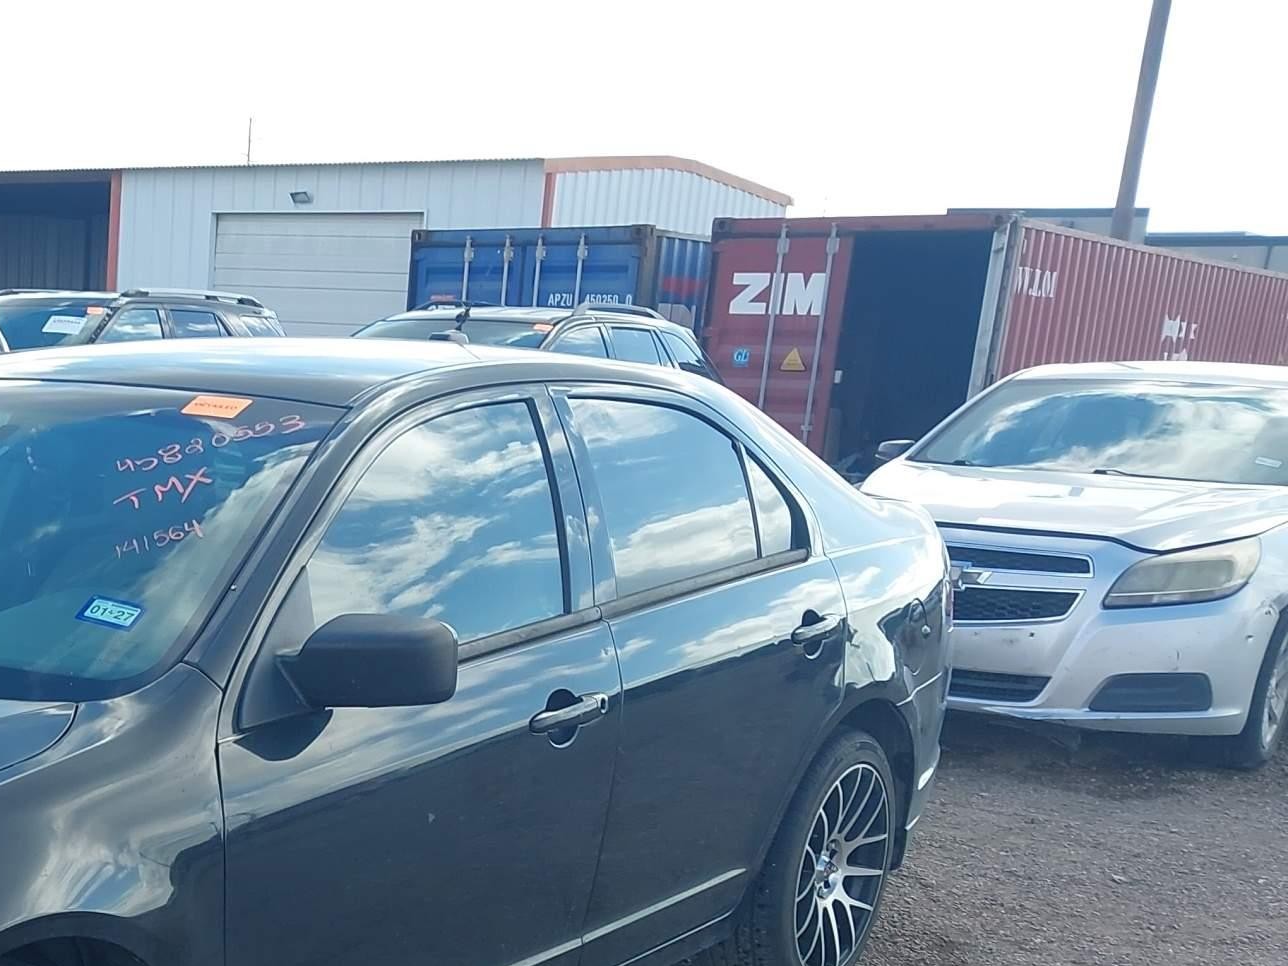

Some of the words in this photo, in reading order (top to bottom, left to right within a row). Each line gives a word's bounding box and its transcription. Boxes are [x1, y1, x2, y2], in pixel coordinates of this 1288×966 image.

[547, 293, 573, 306] APZU
[729, 272, 827, 316] ZIM
[112, 466, 213, 510] TMX
[114, 519, 204, 559] 141564
